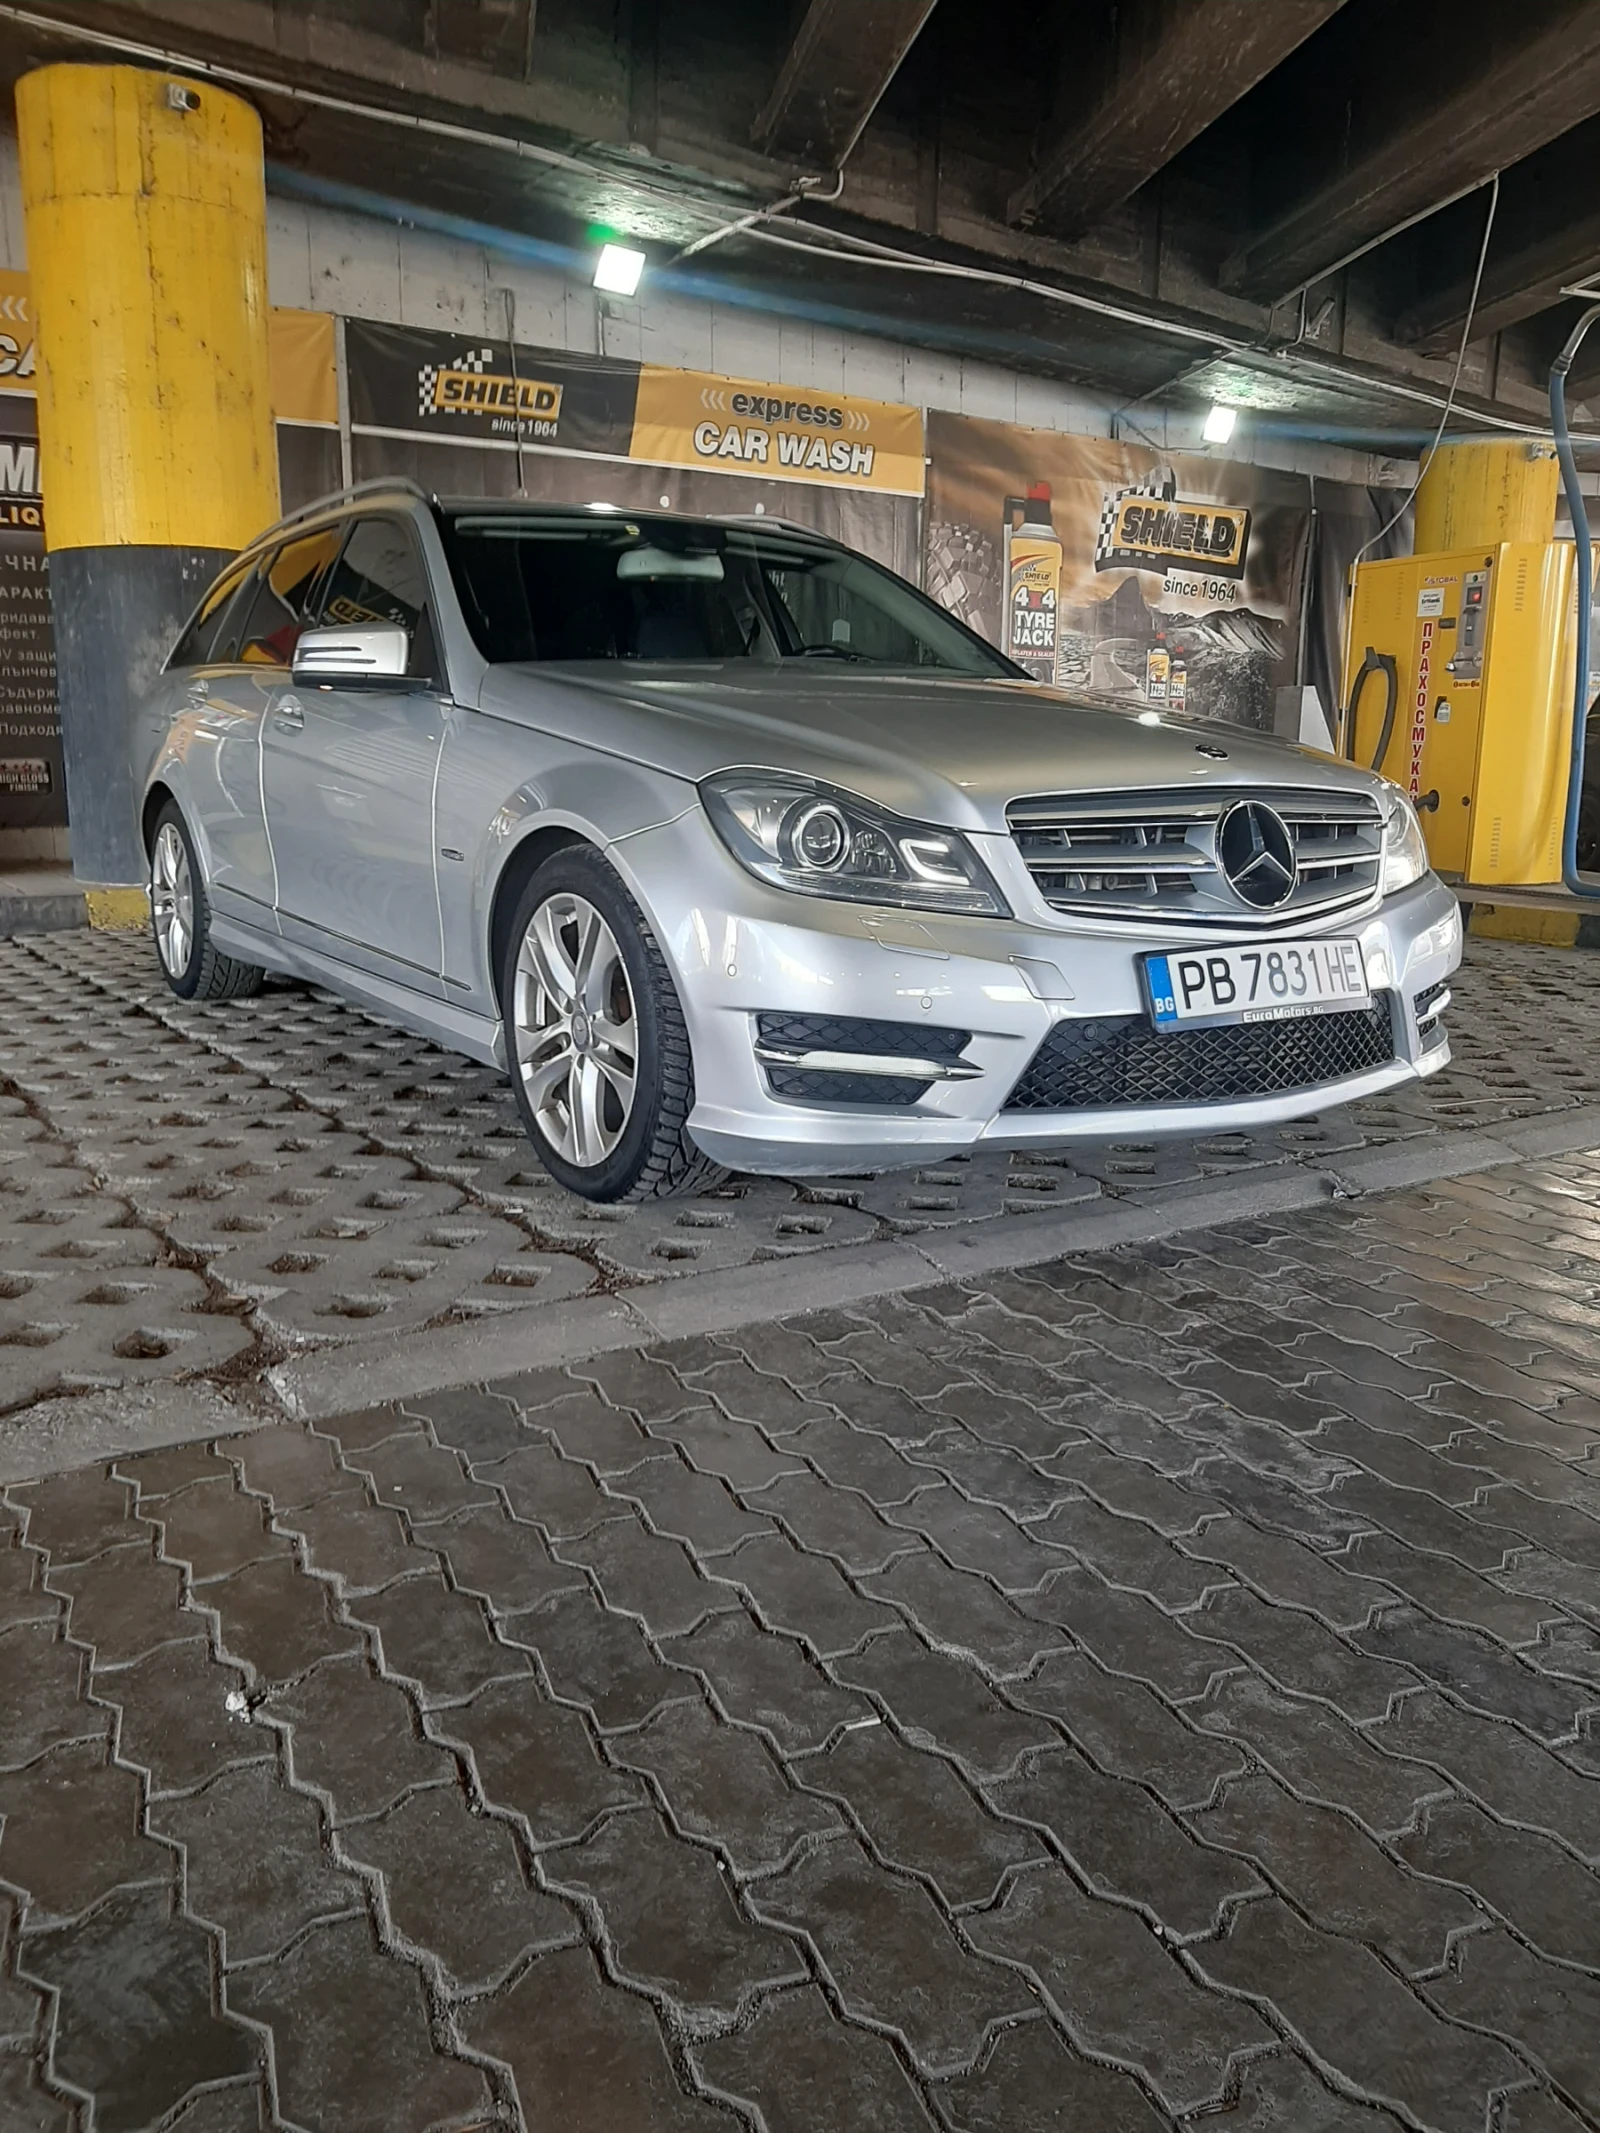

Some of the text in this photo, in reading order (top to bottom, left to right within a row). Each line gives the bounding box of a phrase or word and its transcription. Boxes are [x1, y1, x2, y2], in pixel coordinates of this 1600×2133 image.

[443, 377, 557, 412] SHIELD
[731, 392, 844, 429] express
[491, 418, 558, 438] since 1964
[693, 421, 875, 476] CAR WASH
[1120, 506, 1237, 558] SHIELD
[1163, 578, 1236, 603] since 1964
[1015, 610, 1055, 629] TYRE
[1013, 628, 1055, 647] JACK
[1410, 622, 1433, 803] ПРАХОСМУКА
[1178, 946, 1362, 1010] PB 7831 HE
[1155, 997, 1174, 1014] BG
